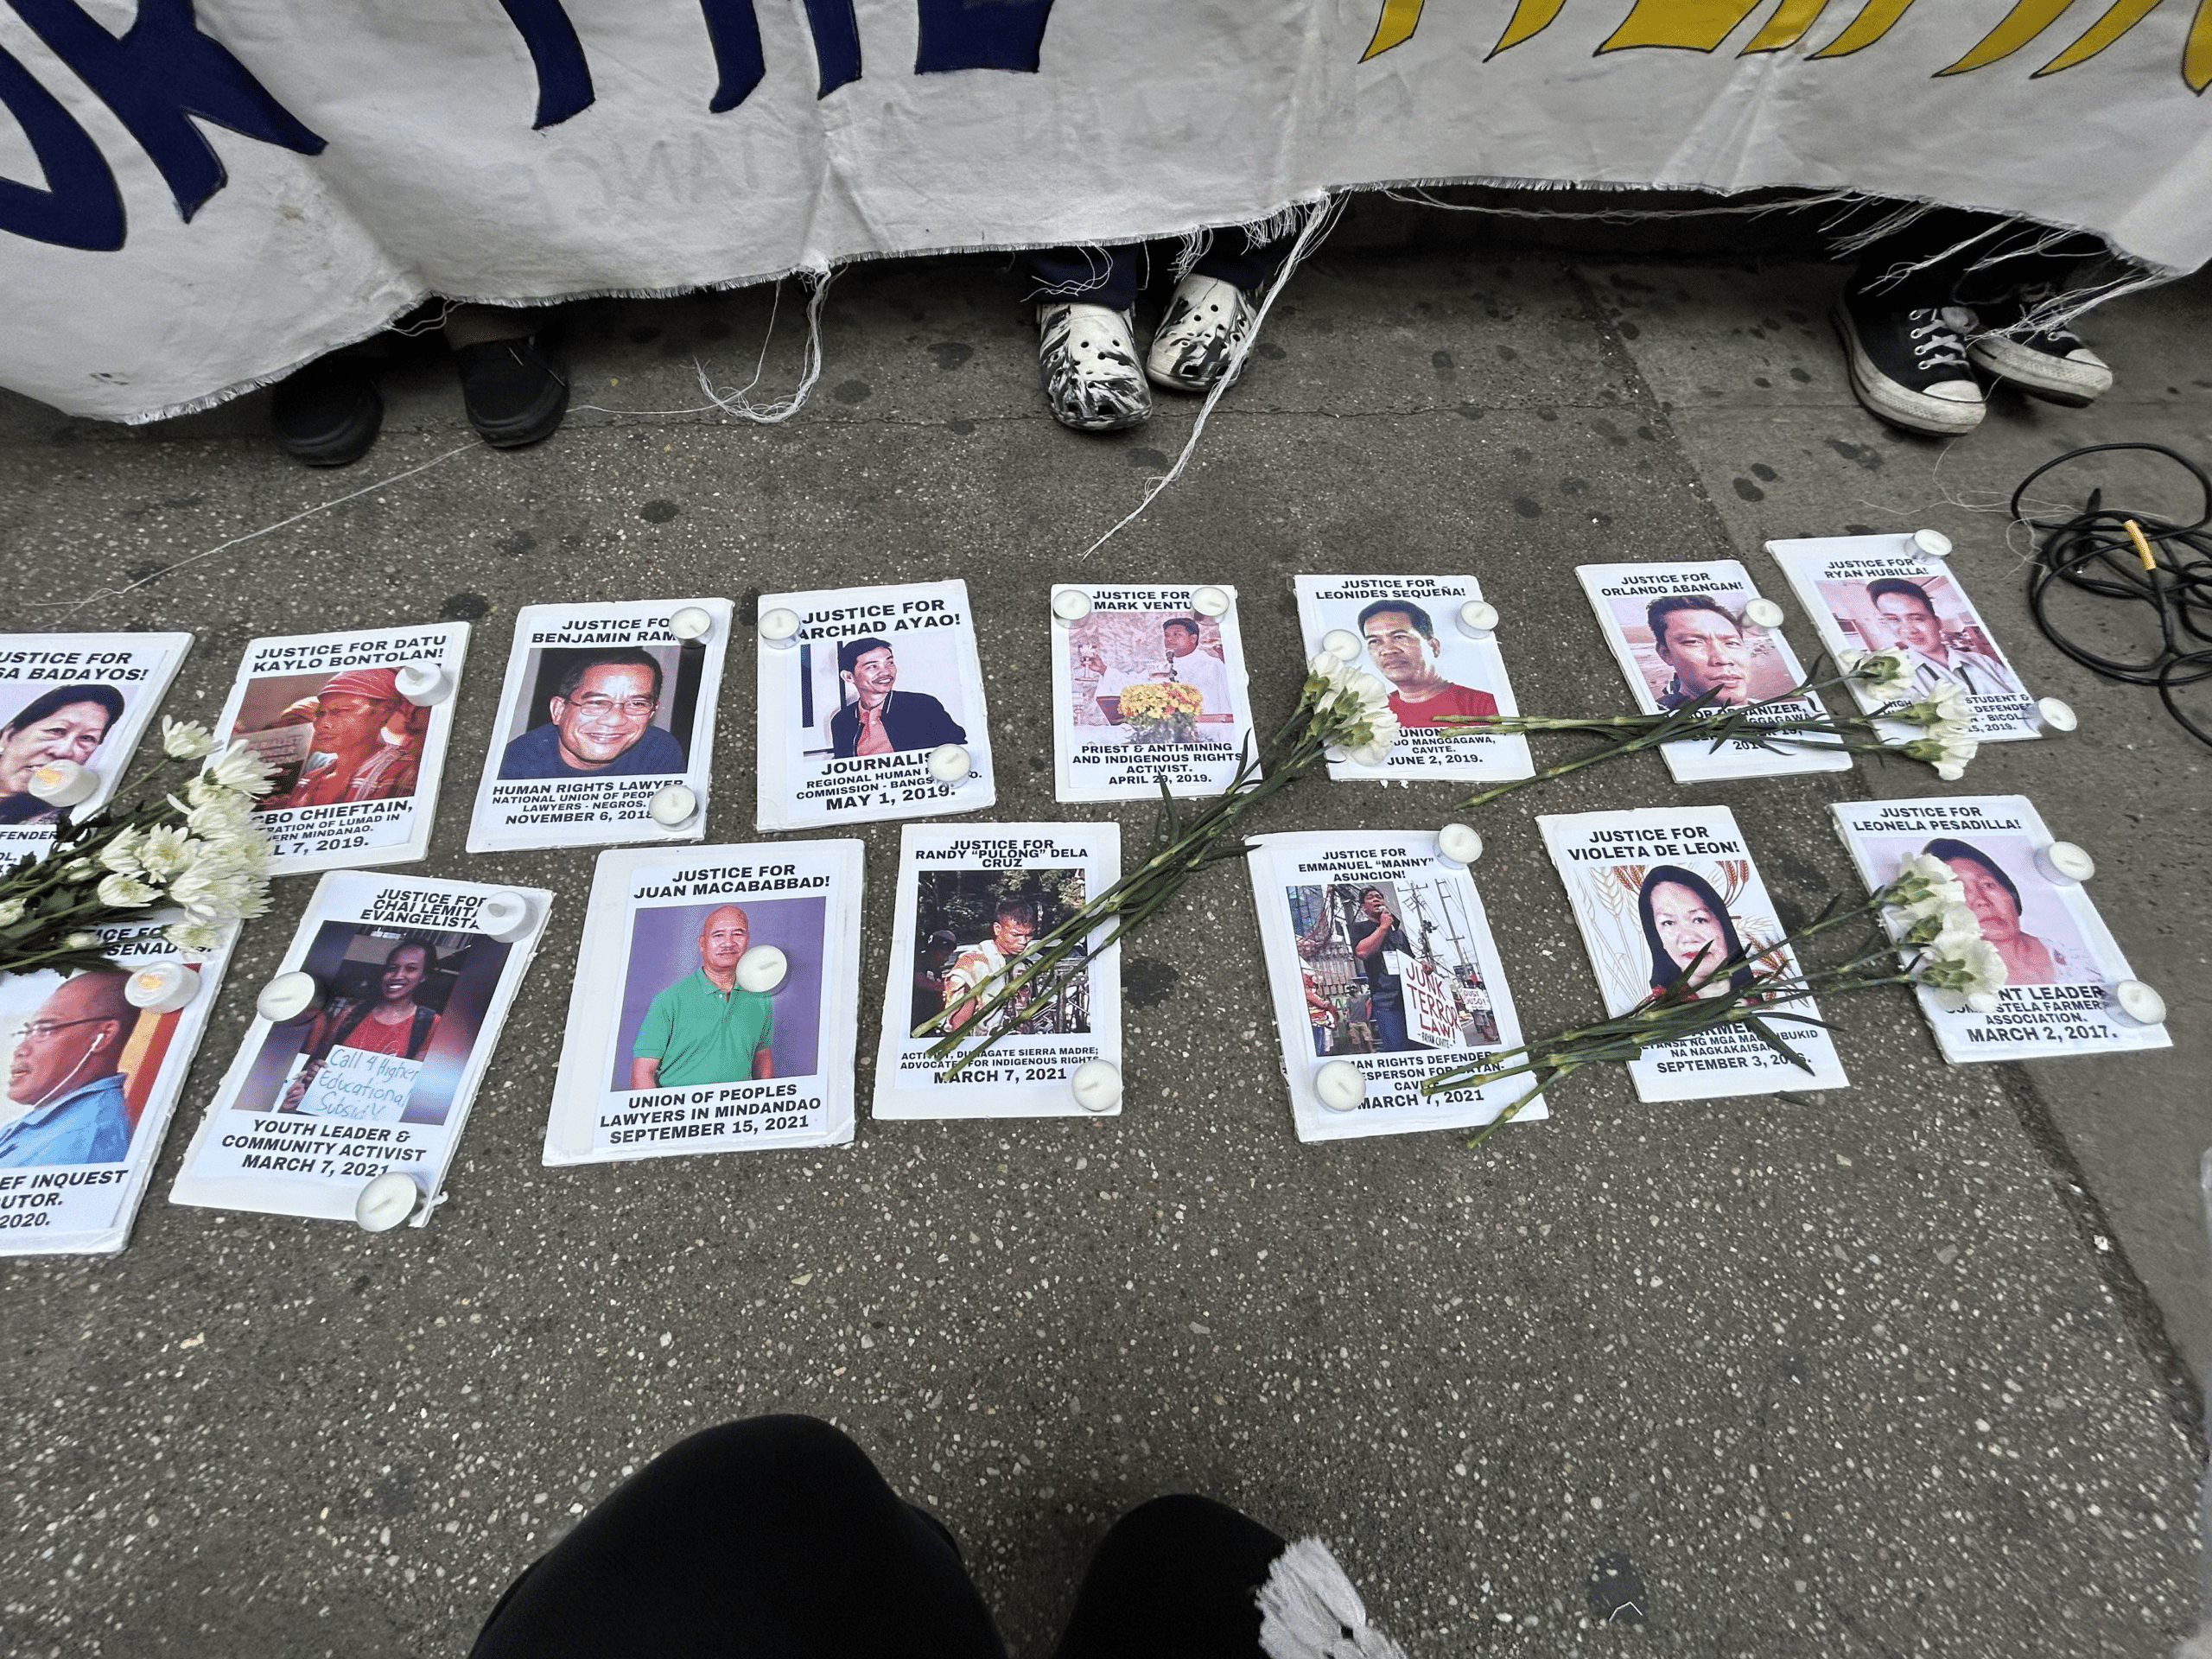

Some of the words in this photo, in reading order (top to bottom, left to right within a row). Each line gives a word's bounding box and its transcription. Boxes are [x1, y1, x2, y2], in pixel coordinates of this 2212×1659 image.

[1827, 559, 1885, 569] JUSTICE
[1886, 559, 1914, 568] FOR
[1621, 574, 1679, 585] JUSTICE
[1681, 573, 1711, 582] FOR
[1824, 569, 1863, 579] RYAN
[1865, 567, 1929, 577] HUBILLA!
[1341, 580, 1402, 589] JUSTICE
[1407, 579, 1435, 588] FOR
[1601, 586, 1668, 596] ORLANDO
[1673, 582, 1744, 594] ABANGAN!
[1092, 591, 1156, 600] JUSTICE
[1160, 591, 1190, 600] FOR
[1315, 589, 1389, 600] LEONIDES
[1392, 586, 1466, 599] SEQUEÑA!
[802, 604, 895, 624] JUSTICE
[902, 599, 945, 614] FOR
[1094, 601, 1139, 610] MARK
[1142, 601, 1192, 610] VENTU
[562, 620, 642, 630] JUSTICE
[647, 618, 670, 628] FO
[893, 613, 961, 632] AYAO!
[531, 632, 632, 644] BENJAMIN
[255, 644, 343, 659] JUSTICE
[348, 641, 387, 653] FOR
[394, 635, 447, 648] DATU
[0, 652, 82, 664] USTICE
[86, 652, 132, 664] FOR
[252, 658, 322, 672] KAYLO
[328, 648, 443, 667] BONTOLAN!
[27, 668, 149, 681] BADAYOS!
[1966, 696, 2017, 704] STUDENT
[1985, 723, 2017, 732] 2019.
[1082, 745, 1129, 753] PRIEST
[1134, 744, 1144, 753] &
[1147, 742, 1232, 753] ANTI-MINING
[1412, 736, 1497, 746] MANGGAGAWA,
[1072, 755, 1101, 764] AND
[1105, 753, 1189, 764] INDIGENOUS
[1193, 753, 1243, 762] RIGHTS
[1387, 756, 1425, 766] JUNE
[1428, 755, 1442, 766] 2,
[1446, 754, 1483, 763] 2019.
[1126, 764, 1193, 773] ACTIVIST.
[806, 774, 872, 789] REGIONAL
[875, 768, 921, 780] HUMAN
[1109, 775, 1148, 785] APRIL
[1177, 774, 1211, 783] 2019.
[493, 785, 552, 795] HUMAN
[556, 782, 614, 793] RIGHTS
[796, 783, 879, 799] COMMISSION
[492, 795, 556, 804] NATIONAL
[559, 793, 599, 802] UNION
[826, 794, 871, 810] MAY
[879, 792, 896, 805] 1,
[902, 785, 956, 801] 2019.
[300, 800, 412, 821] CHIEFTAIN,
[523, 803, 582, 812] LAWYERS
[593, 800, 646, 810] NEGROS.
[1879, 807, 1948, 817] JUSTICE
[1949, 807, 1983, 817] FOR
[339, 815, 382, 826] LUMAD
[505, 811, 594, 825] NOVEMBER
[599, 811, 613, 822] 6,
[1853, 820, 1928, 831] LEONELA
[1930, 818, 2021, 830] PESADILLA!
[302, 824, 374, 839] MINDANAO.
[1589, 830, 1666, 842] JUSTICE
[1672, 826, 1709, 838] FOR
[293, 842, 309, 855] 7,
[315, 836, 369, 851] 2019.
[950, 840, 1019, 850] JUSTICE
[1023, 839, 1054, 849] FOR
[915, 849, 968, 860] RANDY
[1051, 849, 1088, 858] DELA
[1322, 849, 1377, 860] JUSTICE
[1380, 849, 1407, 857] FOR
[1567, 846, 1649, 861] VIOLETA
[1655, 845, 1681, 856] DE
[1685, 842, 1740, 855] LEON!
[982, 859, 1023, 868] CRUZ
[1299, 861, 1373, 873] EMMANUEL
[671, 866, 753, 882] JUSTICE
[759, 864, 796, 877] FOR
[1332, 870, 1406, 882] ASUNCION!
[633, 885, 687, 899] JUAN
[692, 875, 830, 896] MACABABBAD!
[377, 888, 451, 905] JUSTICE
[372, 899, 416, 912] CHAI
[359, 909, 480, 930] EVANGELISTA
[1406, 962, 1446, 1001] JUNK
[2028, 985, 2102, 1000] LEADER
[1407, 983, 1463, 1032] TERROR
[1986, 1012, 2088, 1025] ASSOCIATION.
[1420, 1014, 1456, 1044] LAW!
[1966, 1027, 2039, 1042] MARCH
[2043, 1027, 2063, 1042] 2,
[2064, 1025, 2118, 1039] 2017.
[1691, 1038, 1707, 1046] NG
[1710, 1036, 1736, 1046] MGA
[1058, 1046, 1099, 1055] MADRE;
[330, 1048, 363, 1069] Call
[366, 1055, 378, 1071] 4
[376, 1058, 419, 1083] Higher
[992, 1057, 1058, 1066] INDIGENOUS
[1377, 1057, 1423, 1068] RIGHTS
[1656, 1058, 1749, 1073] SEPTEMBER
[1751, 1056, 1767, 1068] 3,
[934, 1070, 998, 1084] MARCH
[1004, 1069, 1020, 1084] 7,
[1026, 1068, 1066, 1080] 2021
[628, 1094, 685, 1109] UNION
[690, 1090, 715, 1104] OF
[719, 1084, 798, 1102] PEOPLES
[1357, 1094, 1419, 1109] MARCH
[1443, 1090, 1484, 1103] 2021
[600, 1109, 685, 1128] LAWYERS
[690, 1108, 709, 1120] IN
[715, 1097, 822, 1117] MINDANDAO
[253, 1120, 316, 1137] YOUTH
[319, 1126, 391, 1142] LEADER
[395, 1131, 411, 1142] &
[609, 1123, 725, 1144] SEPTEMBER
[732, 1121, 759, 1135] 15,
[765, 1115, 809, 1131] 2021
[221, 1135, 337, 1155] COMMUNITY
[340, 1145, 427, 1161] ACTIVIST
[241, 1154, 316, 1173] MARCH
[321, 1160, 336, 1177] 7,
[341, 1162, 389, 1177] 2021
[30, 1169, 129, 1189] INQUEST
[0, 1192, 63, 1209] UTOR.
